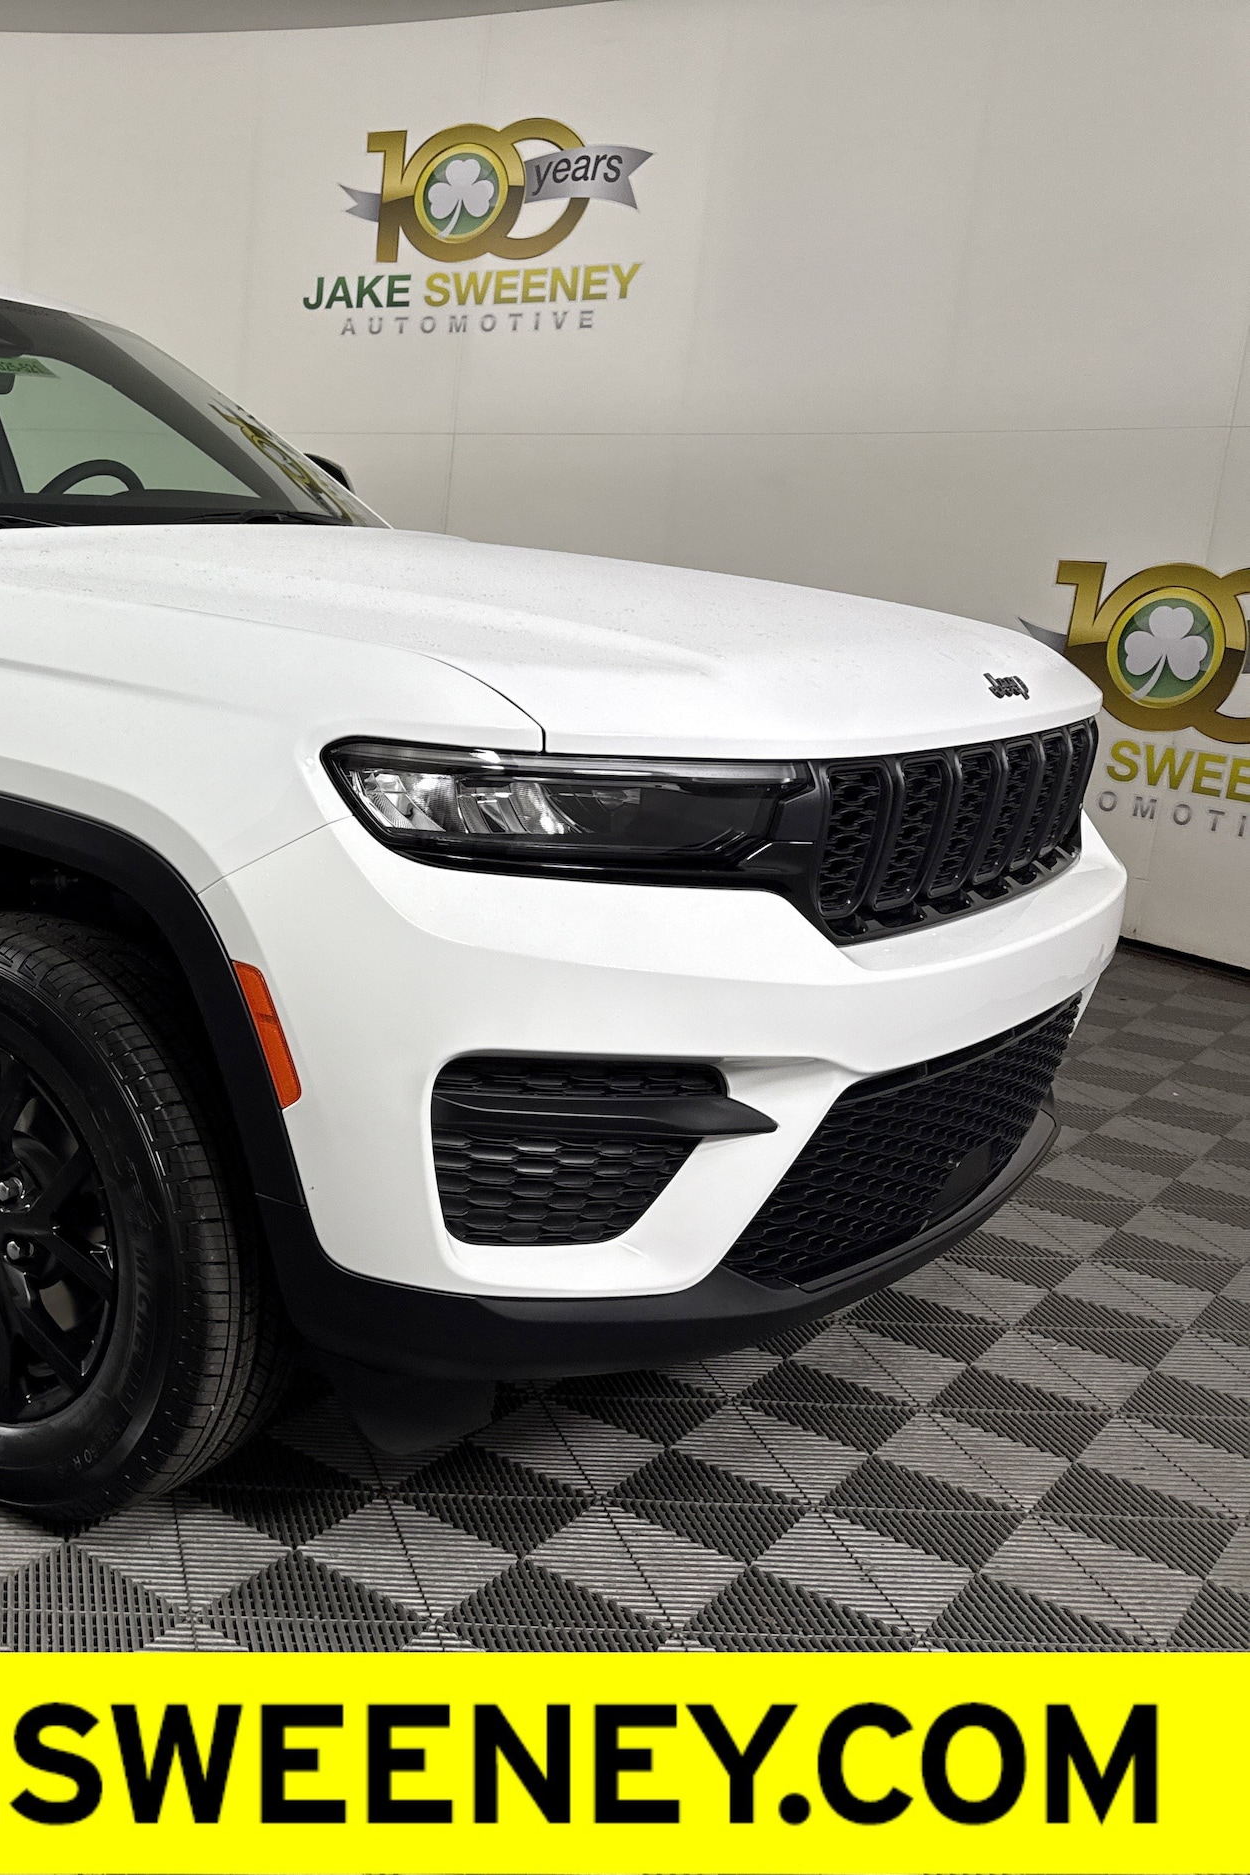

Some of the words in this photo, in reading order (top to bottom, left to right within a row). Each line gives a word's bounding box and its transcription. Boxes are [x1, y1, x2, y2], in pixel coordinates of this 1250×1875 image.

[367, 117, 591, 263] 100
[532, 152, 623, 197] years
[303, 274, 412, 310] JAKE
[424, 262, 643, 307] SWEENEY
[340, 310, 595, 336] AUTOMOTIVE
[1106, 740, 1250, 802] SWEE
[1099, 791, 1247, 837] OMOTI
